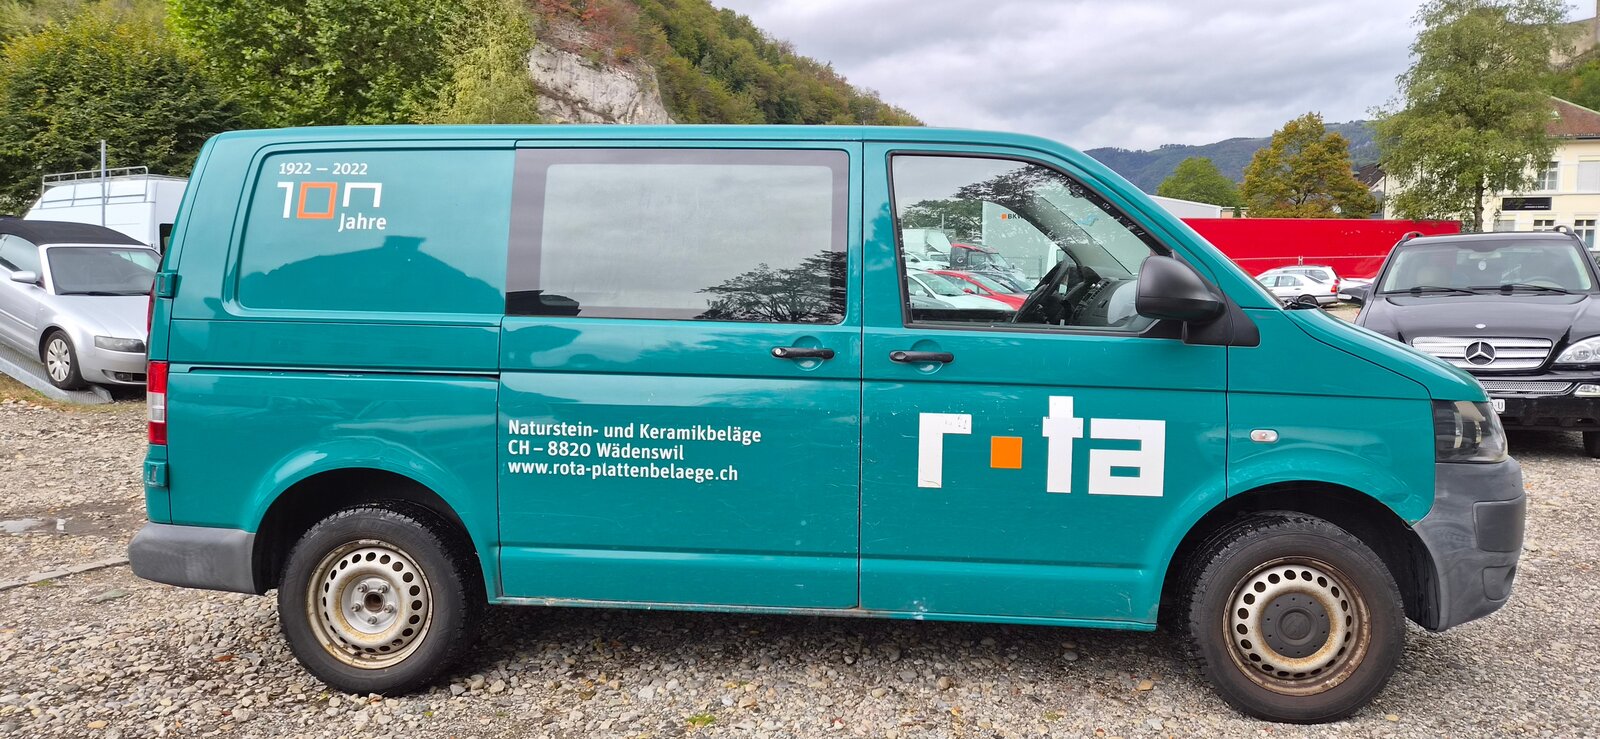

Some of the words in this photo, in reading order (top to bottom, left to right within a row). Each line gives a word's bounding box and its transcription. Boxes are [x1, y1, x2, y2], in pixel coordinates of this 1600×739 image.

[279, 162, 312, 175] 1922
[332, 163, 368, 175] 2022
[337, 212, 387, 232] Jahre
[508, 419, 599, 438] Naturstein-
[604, 423, 634, 438] und
[639, 423, 762, 446] Keramikbeläge
[508, 439, 530, 455] CH
[547, 441, 591, 457] 8820
[596, 442, 684, 460] Wädenswil
[508, 461, 738, 483] www.rota-plattenbelaege.ch
